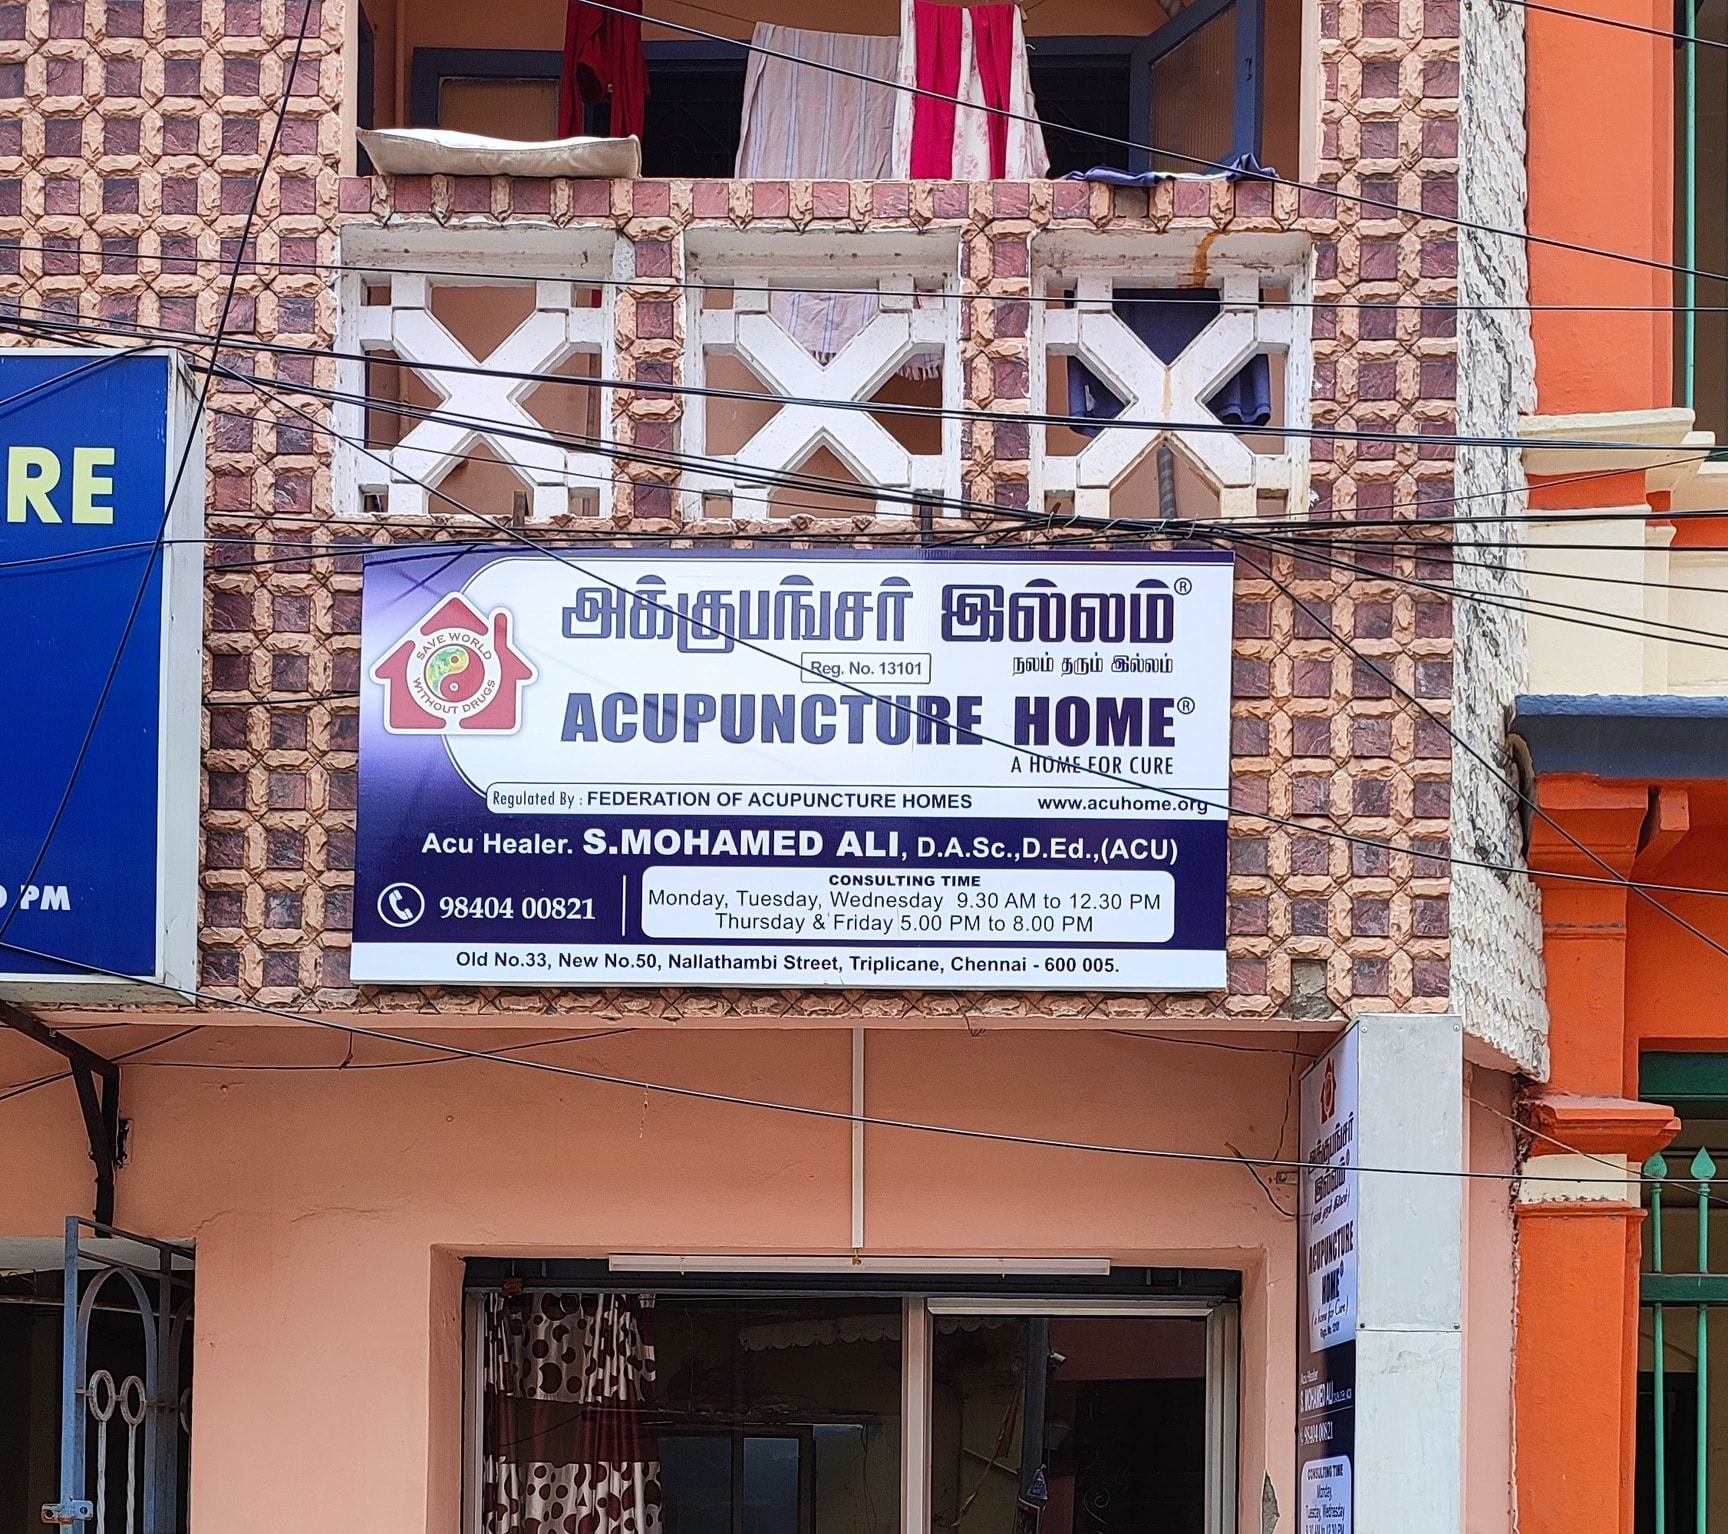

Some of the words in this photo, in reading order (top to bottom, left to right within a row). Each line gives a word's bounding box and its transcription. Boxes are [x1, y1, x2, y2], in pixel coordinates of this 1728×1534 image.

[416, 634, 446, 660] SAVE
[448, 632, 492, 660] WORLD
[810, 661, 845, 678] Reg.
[849, 662, 875, 676] No.
[878, 662, 922, 676] 13101
[1012, 653, 1054, 676] நலம்
[1061, 654, 1103, 677] தரும்
[1111, 654, 1174, 675] இல்லம்
[412, 677, 459, 714] WITHOUT
[462, 679, 496, 713] DRUGS
[560, 692, 983, 746] ACUPUNCTURE
[1010, 756, 1022, 774] A
[1028, 757, 1081, 774] HOME
[1088, 757, 1122, 775] FOR
[1130, 757, 1174, 775] CURE
[492, 790, 556, 809] Regulated
[559, 792, 576, 809] By
[587, 791, 711, 807] FEDERATION
[716, 792, 743, 807] OF
[747, 792, 897, 809] ACUPUNCTURE
[902, 793, 973, 809] HOMES
[1037, 796, 1209, 814] www.acuhome.org
[421, 833, 474, 855] Acu
[483, 833, 574, 855] Healer.
[583, 828, 824, 857] S.MOHAMED
[836, 830, 907, 862] ALI,
[828, 874, 936, 887] CONSULTING
[940, 875, 981, 887] TIME
[20, 884, 71, 911] PM
[439, 896, 514, 919] 98404
[521, 897, 596, 921] 00821
[649, 889, 730, 910] Monday,
[736, 890, 823, 911] Tuesday,
[829, 891, 944, 911] Wednesday
[957, 893, 999, 909] 9.30
[1005, 893, 1037, 909] AM
[1043, 894, 1062, 910] to
[1069, 893, 1122, 910] 12.30
[1130, 894, 1161, 911] PM
[715, 913, 806, 933] Thursday
[812, 914, 826, 930] &
[833, 913, 894, 933] Friday
[900, 914, 942, 931] 5.00
[949, 915, 981, 931] PM
[988, 915, 1006, 931] to
[1013, 915, 1055, 932] 8.00
[1062, 916, 1094, 932] PM
[456, 951, 489, 968] Old
[494, 952, 553, 970] No.33,
[559, 953, 600, 968] New
[604, 953, 662, 971] No.50,
[668, 953, 778, 970] Nallathambi
[783, 954, 844, 973] Street,
[849, 955, 945, 974] Triplicane,
[950, 956, 1027, 972] Chennai
[1044, 957, 1077, 973] 600
[1082, 957, 1120, 973] 005.
[1308, 1220, 1354, 1275] ACUPUNCTURE
[1307, 1465, 1333, 1480] CONSULTING
